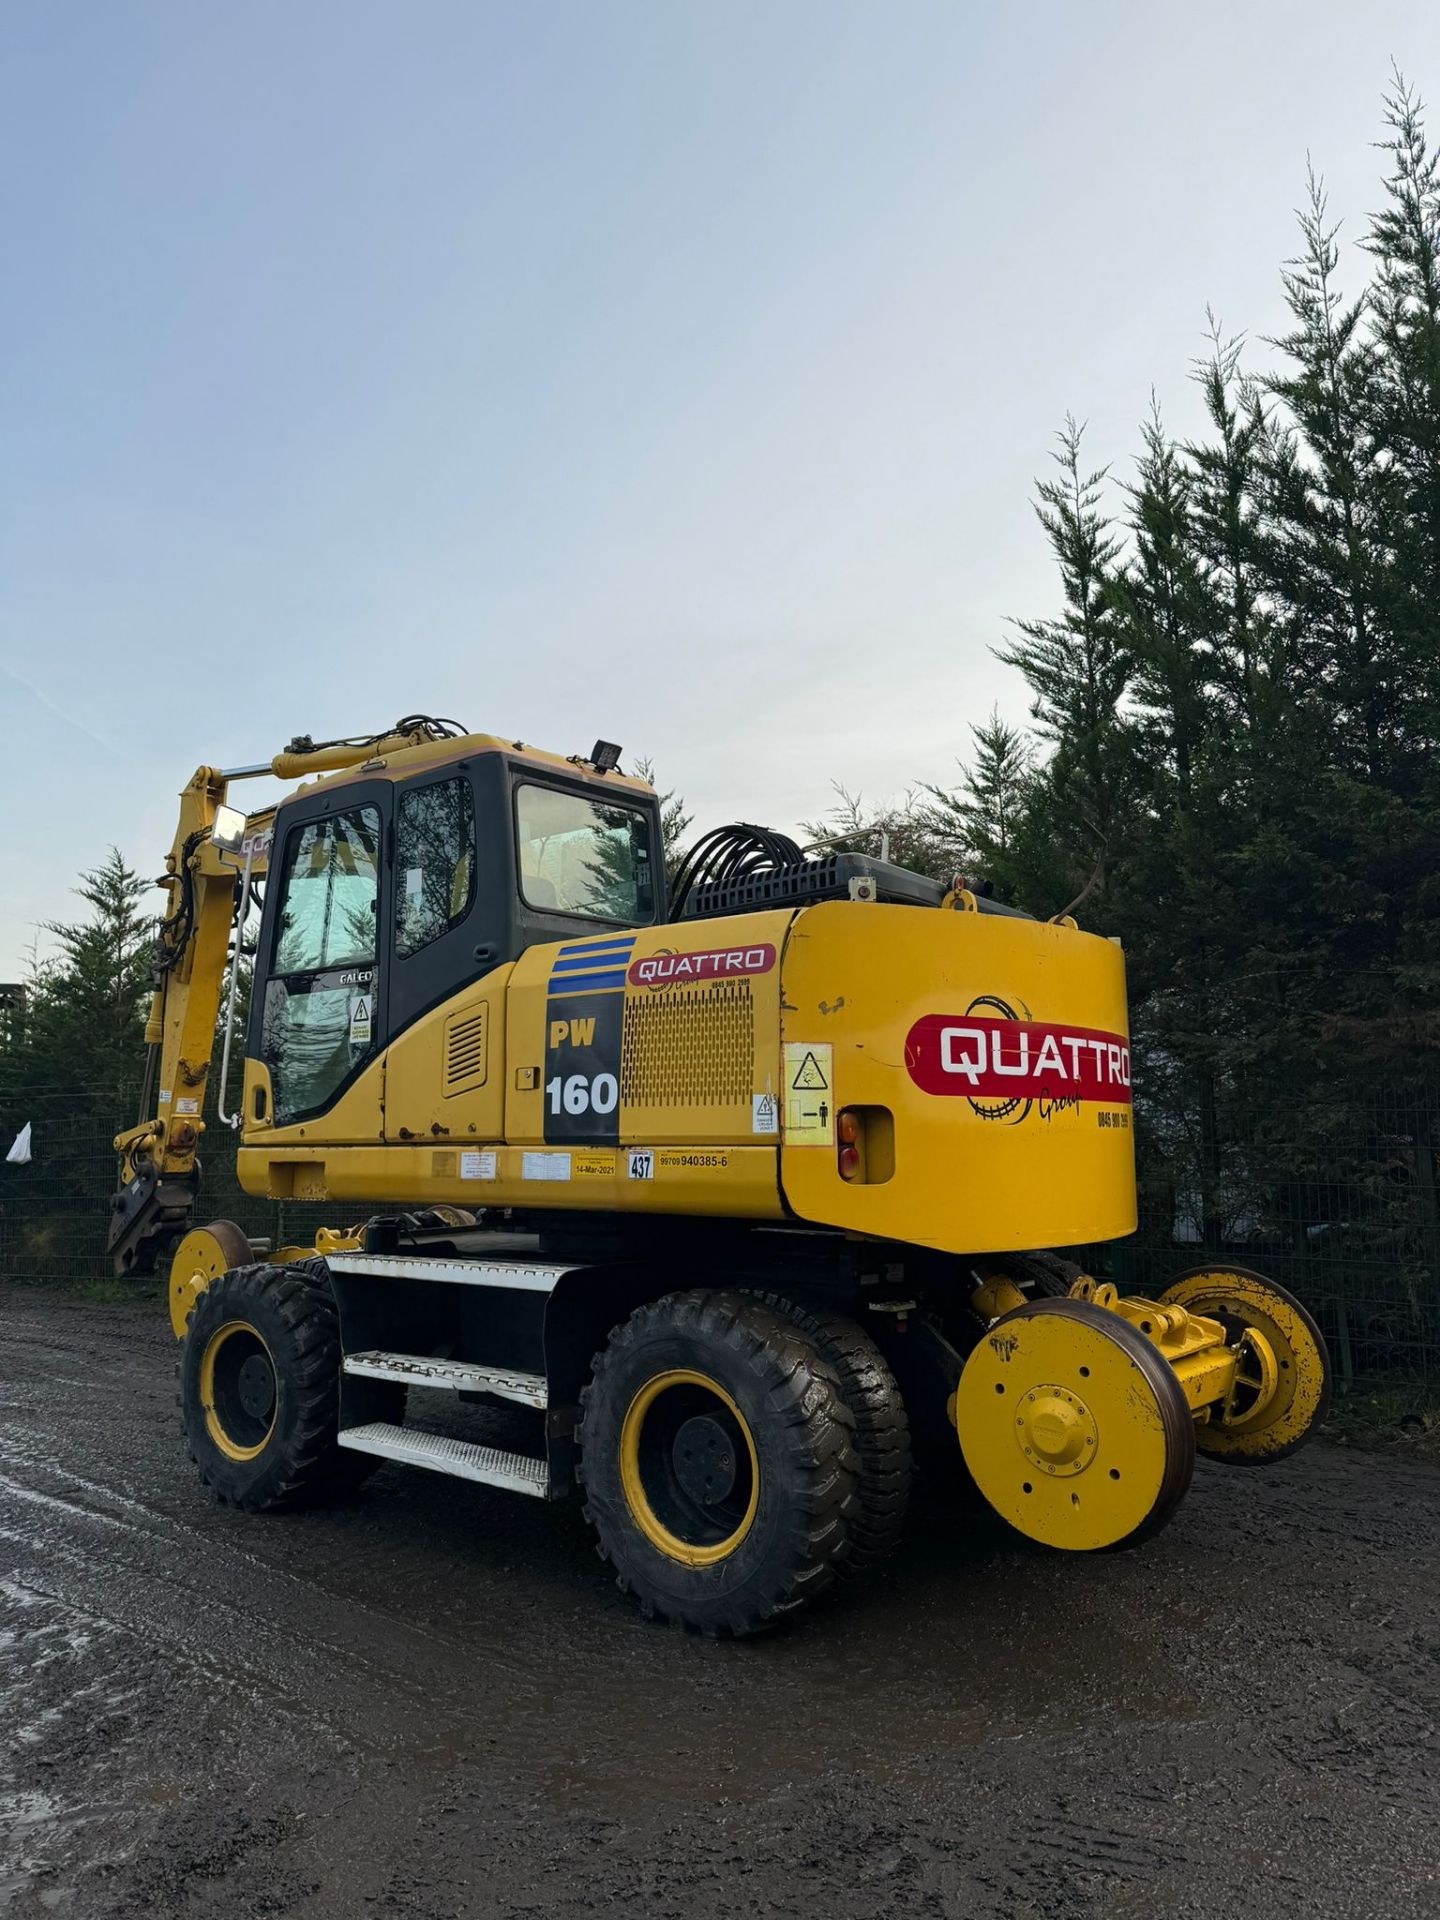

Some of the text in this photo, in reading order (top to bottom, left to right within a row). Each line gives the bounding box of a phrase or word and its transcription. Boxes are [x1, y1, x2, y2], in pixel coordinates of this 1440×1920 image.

[340, 970, 373, 985] GALEO
[639, 949, 765, 981] QUATTRO
[550, 1017, 597, 1049] PW
[940, 1027, 1131, 1087] QUATTRO
[546, 1073, 619, 1115] 160
[1039, 1087, 1083, 1123] Group
[576, 1165, 615, 1174] 14-Mar-2021
[631, 1156, 651, 1178] 437
[660, 1156, 728, 1167] 99709 940385-6
